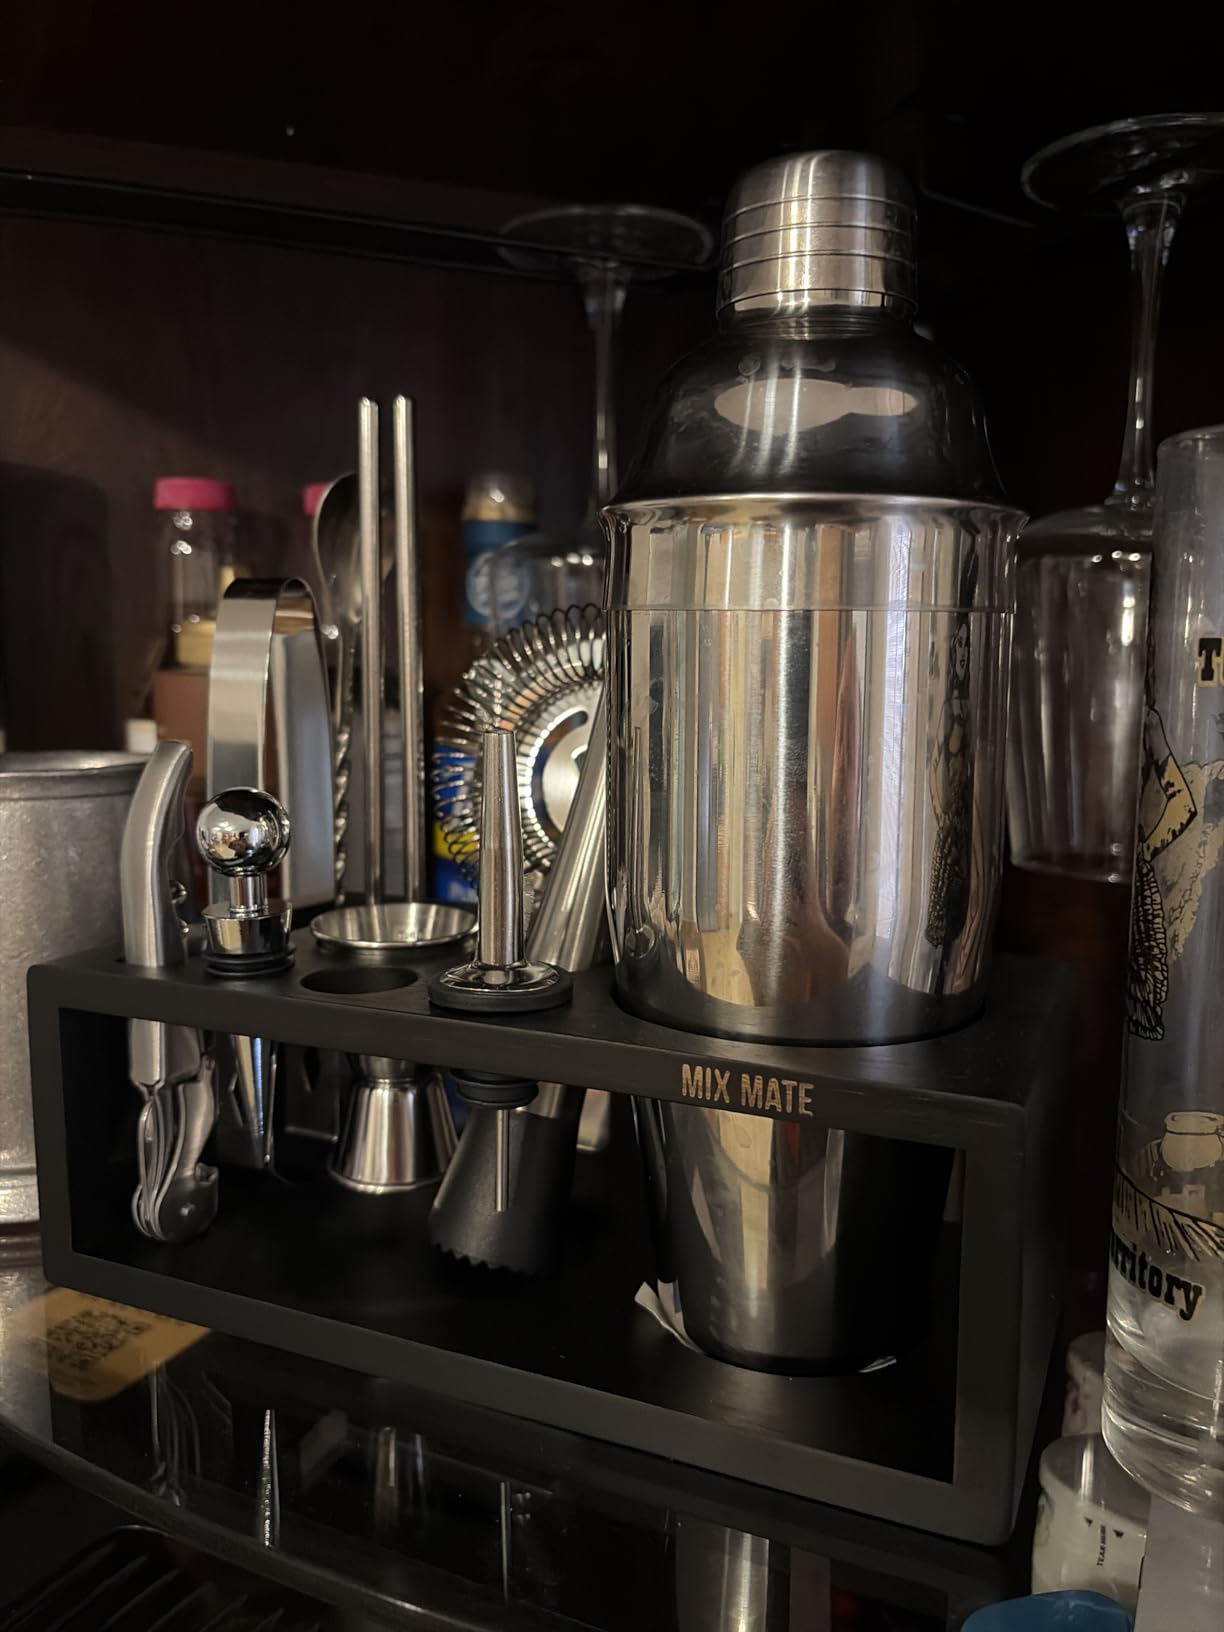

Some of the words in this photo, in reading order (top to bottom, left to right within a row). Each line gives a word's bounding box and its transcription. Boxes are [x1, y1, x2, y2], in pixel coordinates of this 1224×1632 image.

[1198, 637, 1224, 683] T
[682, 1063, 731, 1104] MIX
[741, 1073, 815, 1117] MATE
[1096, 1544, 1106, 1567] TEAR
